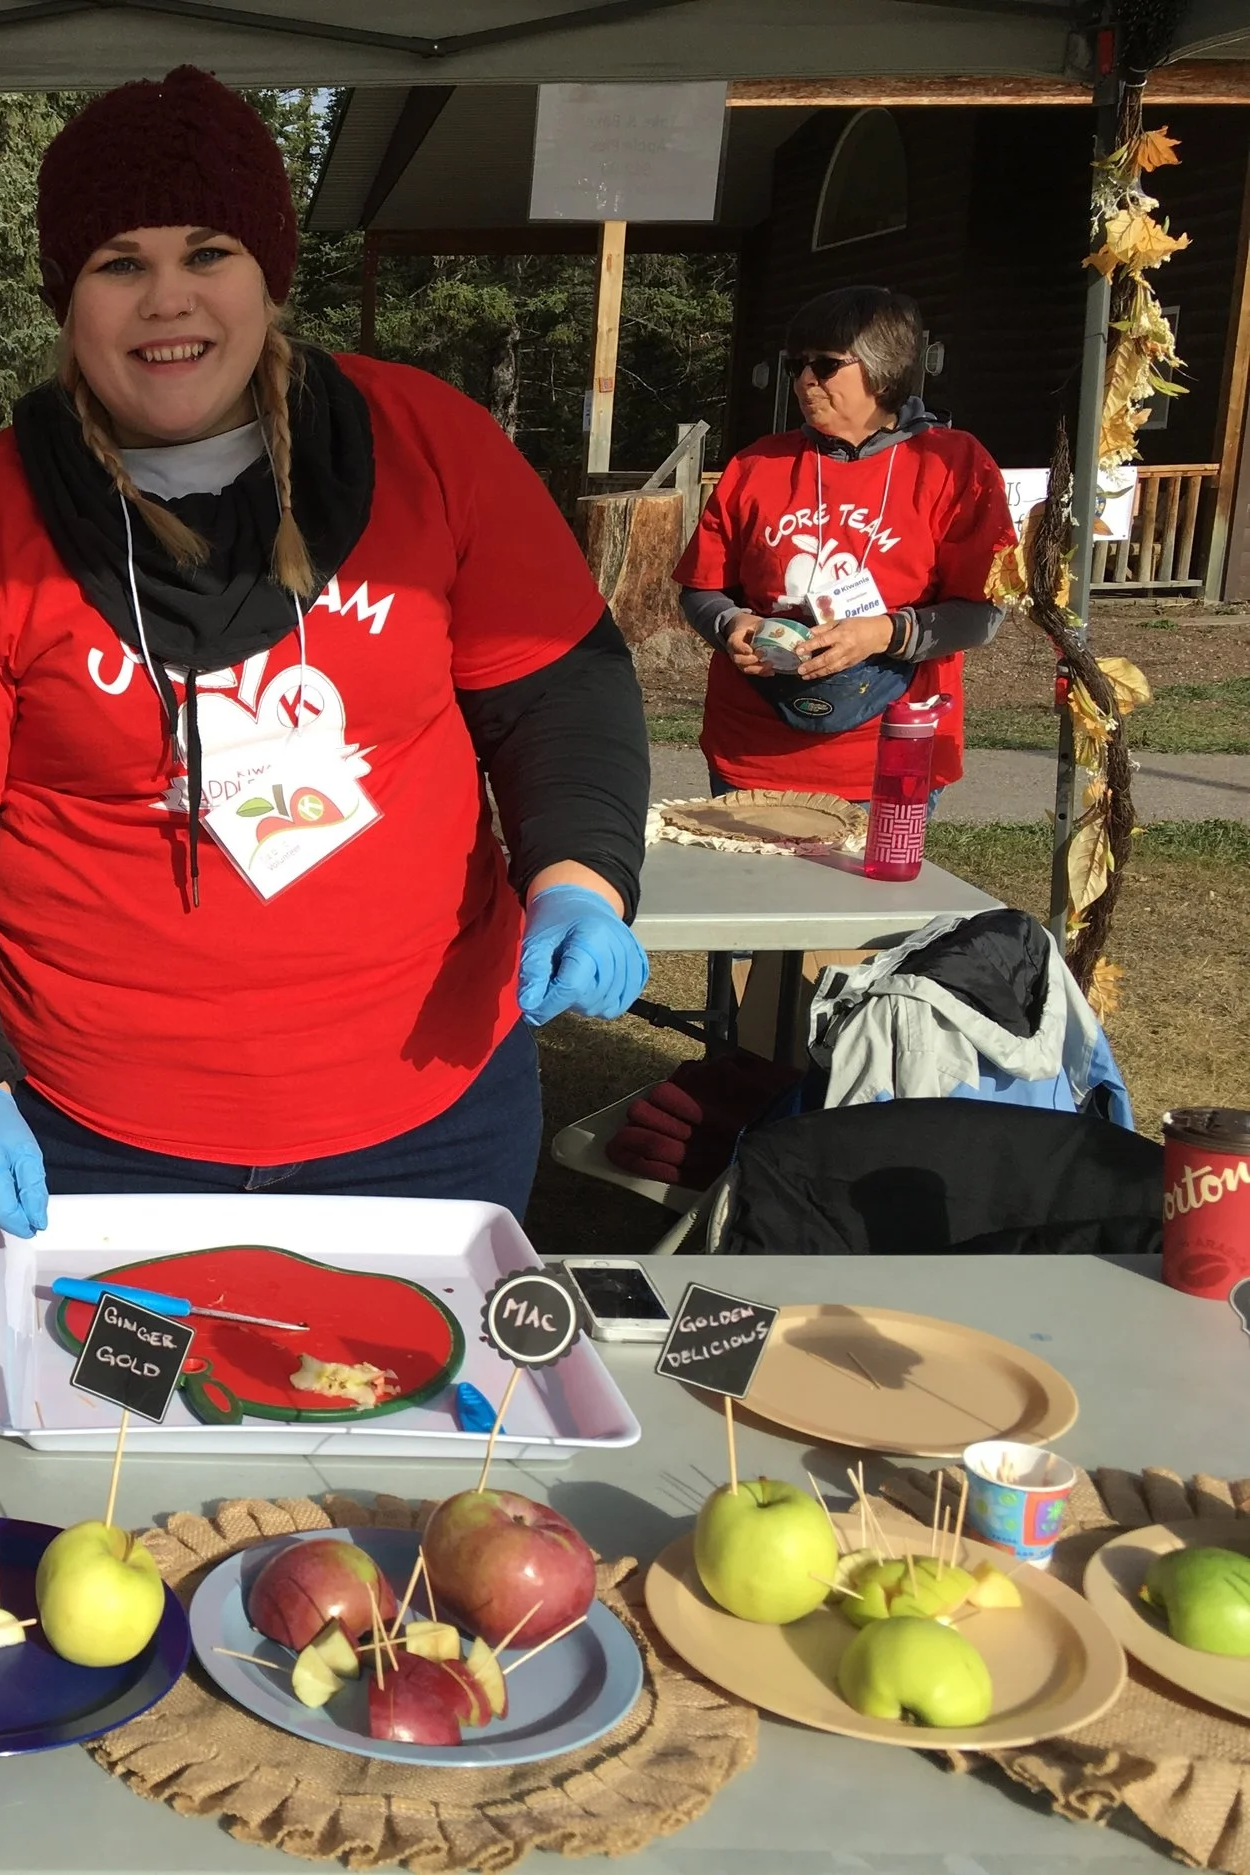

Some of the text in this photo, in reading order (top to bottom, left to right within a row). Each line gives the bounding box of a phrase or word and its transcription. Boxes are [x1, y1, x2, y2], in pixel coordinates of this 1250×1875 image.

[765, 503, 902, 553] CORE TEAM
[833, 560, 851, 581] K
[840, 576, 870, 592] Kiwanis
[844, 599, 880, 618] Darlene
[104, 1306, 178, 1349] GINGER
[678, 1306, 755, 1333] GOLDEN
[667, 1320, 770, 1368] DELICIOUS
[95, 1345, 161, 1378] GOLD
